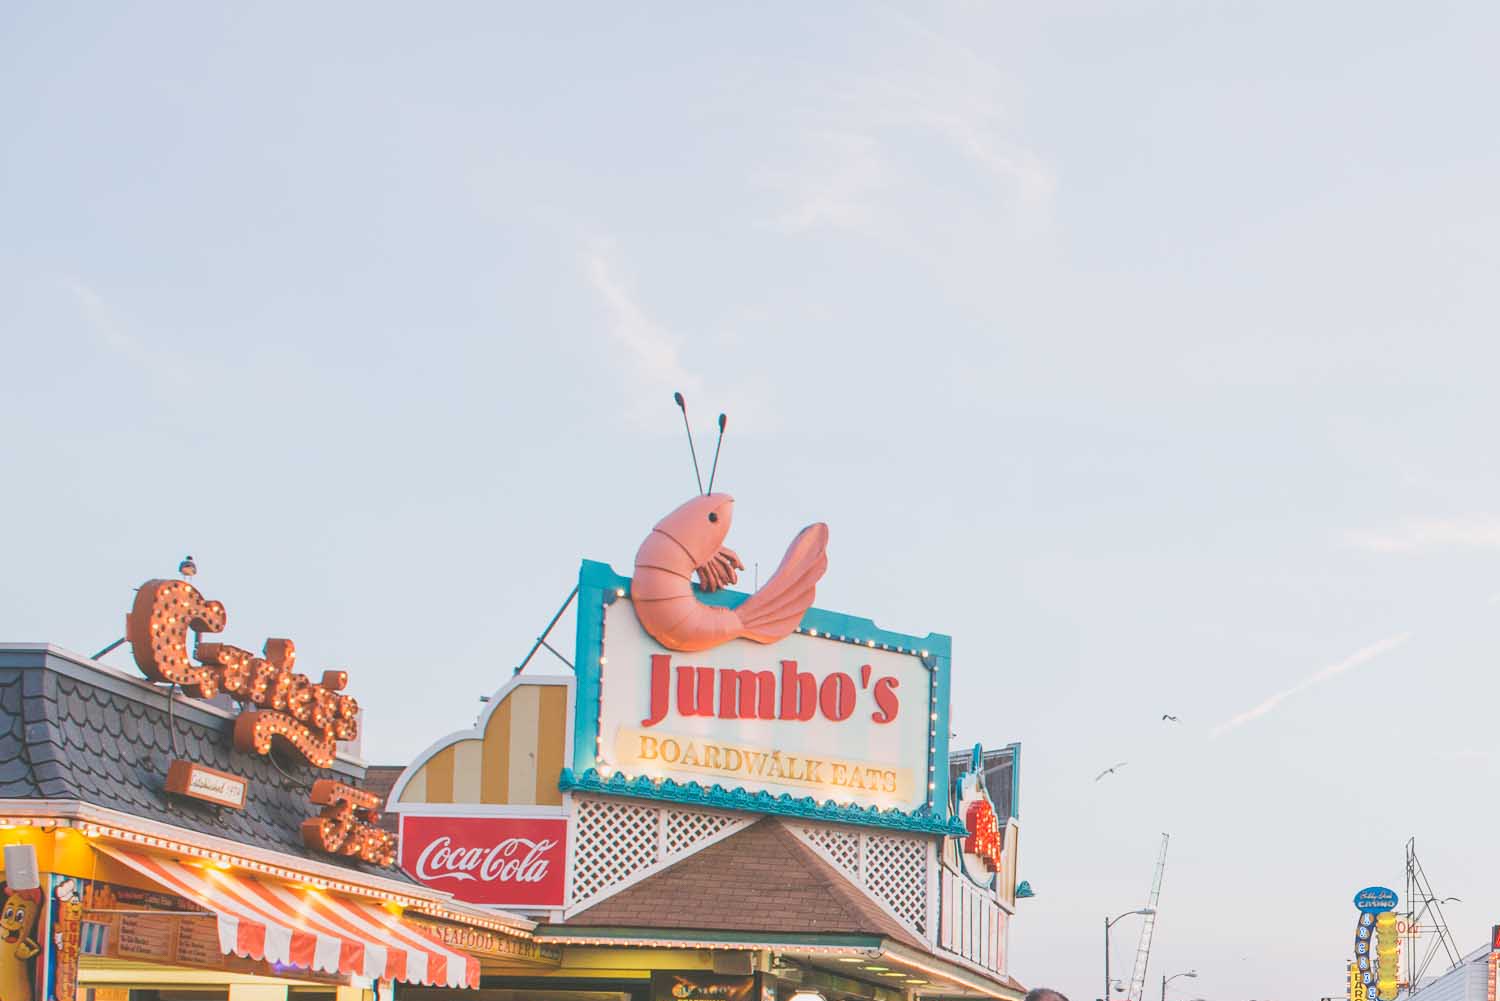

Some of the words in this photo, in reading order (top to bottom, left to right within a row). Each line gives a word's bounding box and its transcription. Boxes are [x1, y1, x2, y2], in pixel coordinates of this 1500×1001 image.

[641, 653, 899, 728] Jumbo's
[639, 734, 825, 784] BOARDWALK
[830, 762, 897, 793] EATS
[416, 836, 559, 883] Coca-Cola
[437, 927, 494, 951] SEAFOOD
[497, 936, 540, 960] EATERY
